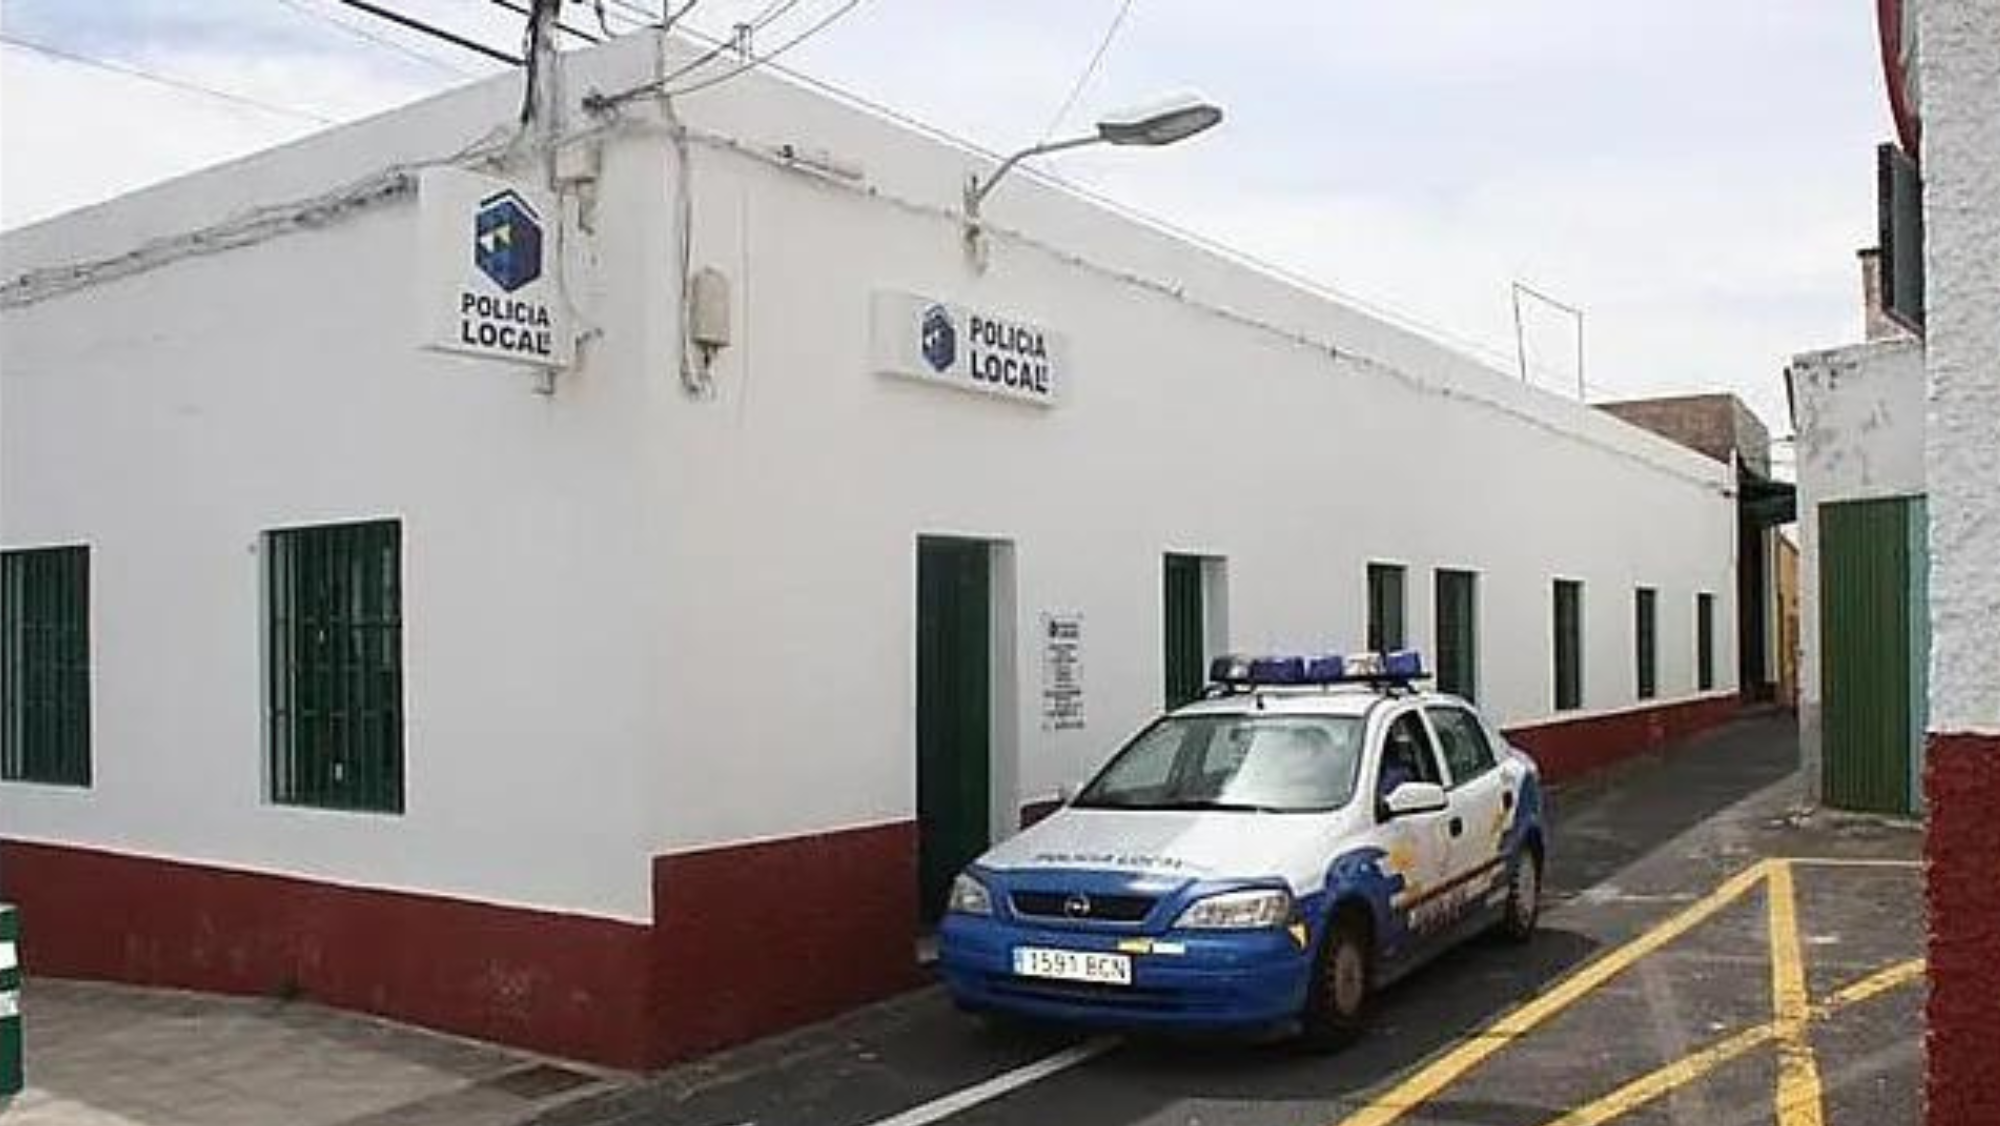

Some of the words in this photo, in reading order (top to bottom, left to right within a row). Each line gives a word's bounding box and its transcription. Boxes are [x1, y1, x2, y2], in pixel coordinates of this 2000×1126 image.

[461, 293, 550, 327] POLICIA
[461, 320, 551, 354] LOCAL
[970, 316, 1047, 358] POLICIA
[971, 351, 1049, 393] LOCAL
[1031, 952, 1077, 975] 1591
[1086, 955, 1126, 979] BCN
